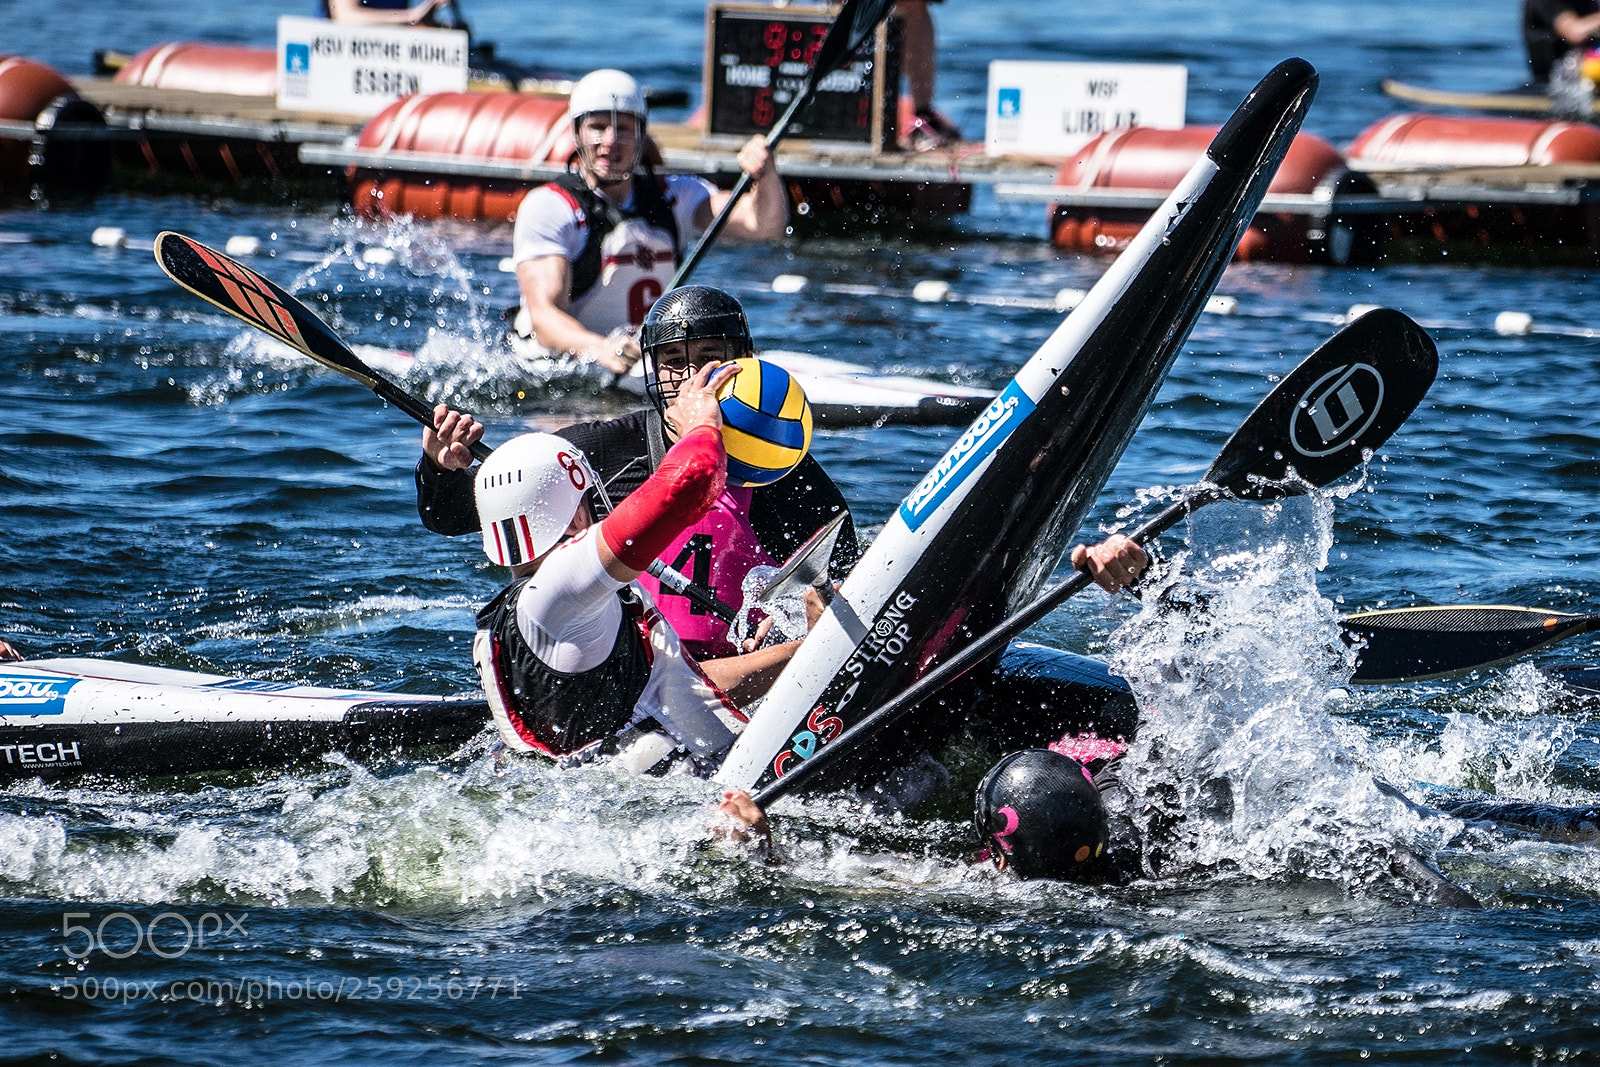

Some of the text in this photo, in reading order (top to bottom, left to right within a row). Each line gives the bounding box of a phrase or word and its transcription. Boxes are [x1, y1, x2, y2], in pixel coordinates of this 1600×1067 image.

[353, 68, 420, 95] ESSEN
[557, 451, 587, 491] 8
[659, 533, 718, 616] 4
[846, 591, 919, 679] STRONG
[874, 622, 913, 667] TOP
[774, 705, 844, 778] CDS
